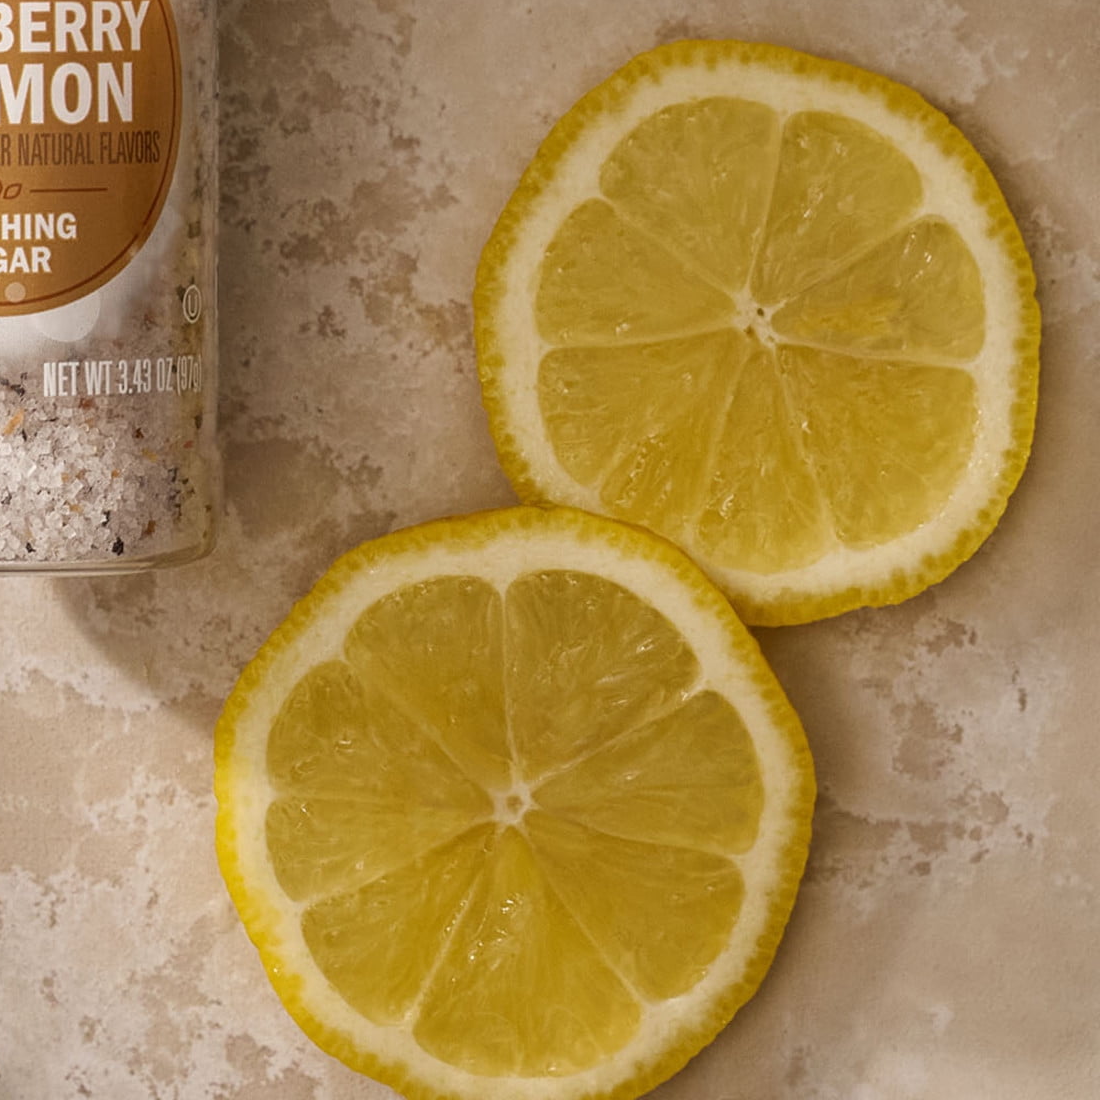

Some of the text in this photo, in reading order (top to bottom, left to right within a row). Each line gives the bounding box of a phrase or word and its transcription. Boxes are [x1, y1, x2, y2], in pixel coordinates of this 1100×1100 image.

[17, 135, 96, 166] NATURAL
[100, 133, 162, 166] FLAVORS
[43, 361, 80, 397] NET
[84, 360, 113, 396] WT
[117, 359, 152, 395] 3.43
[156, 357, 175, 393] OZ
